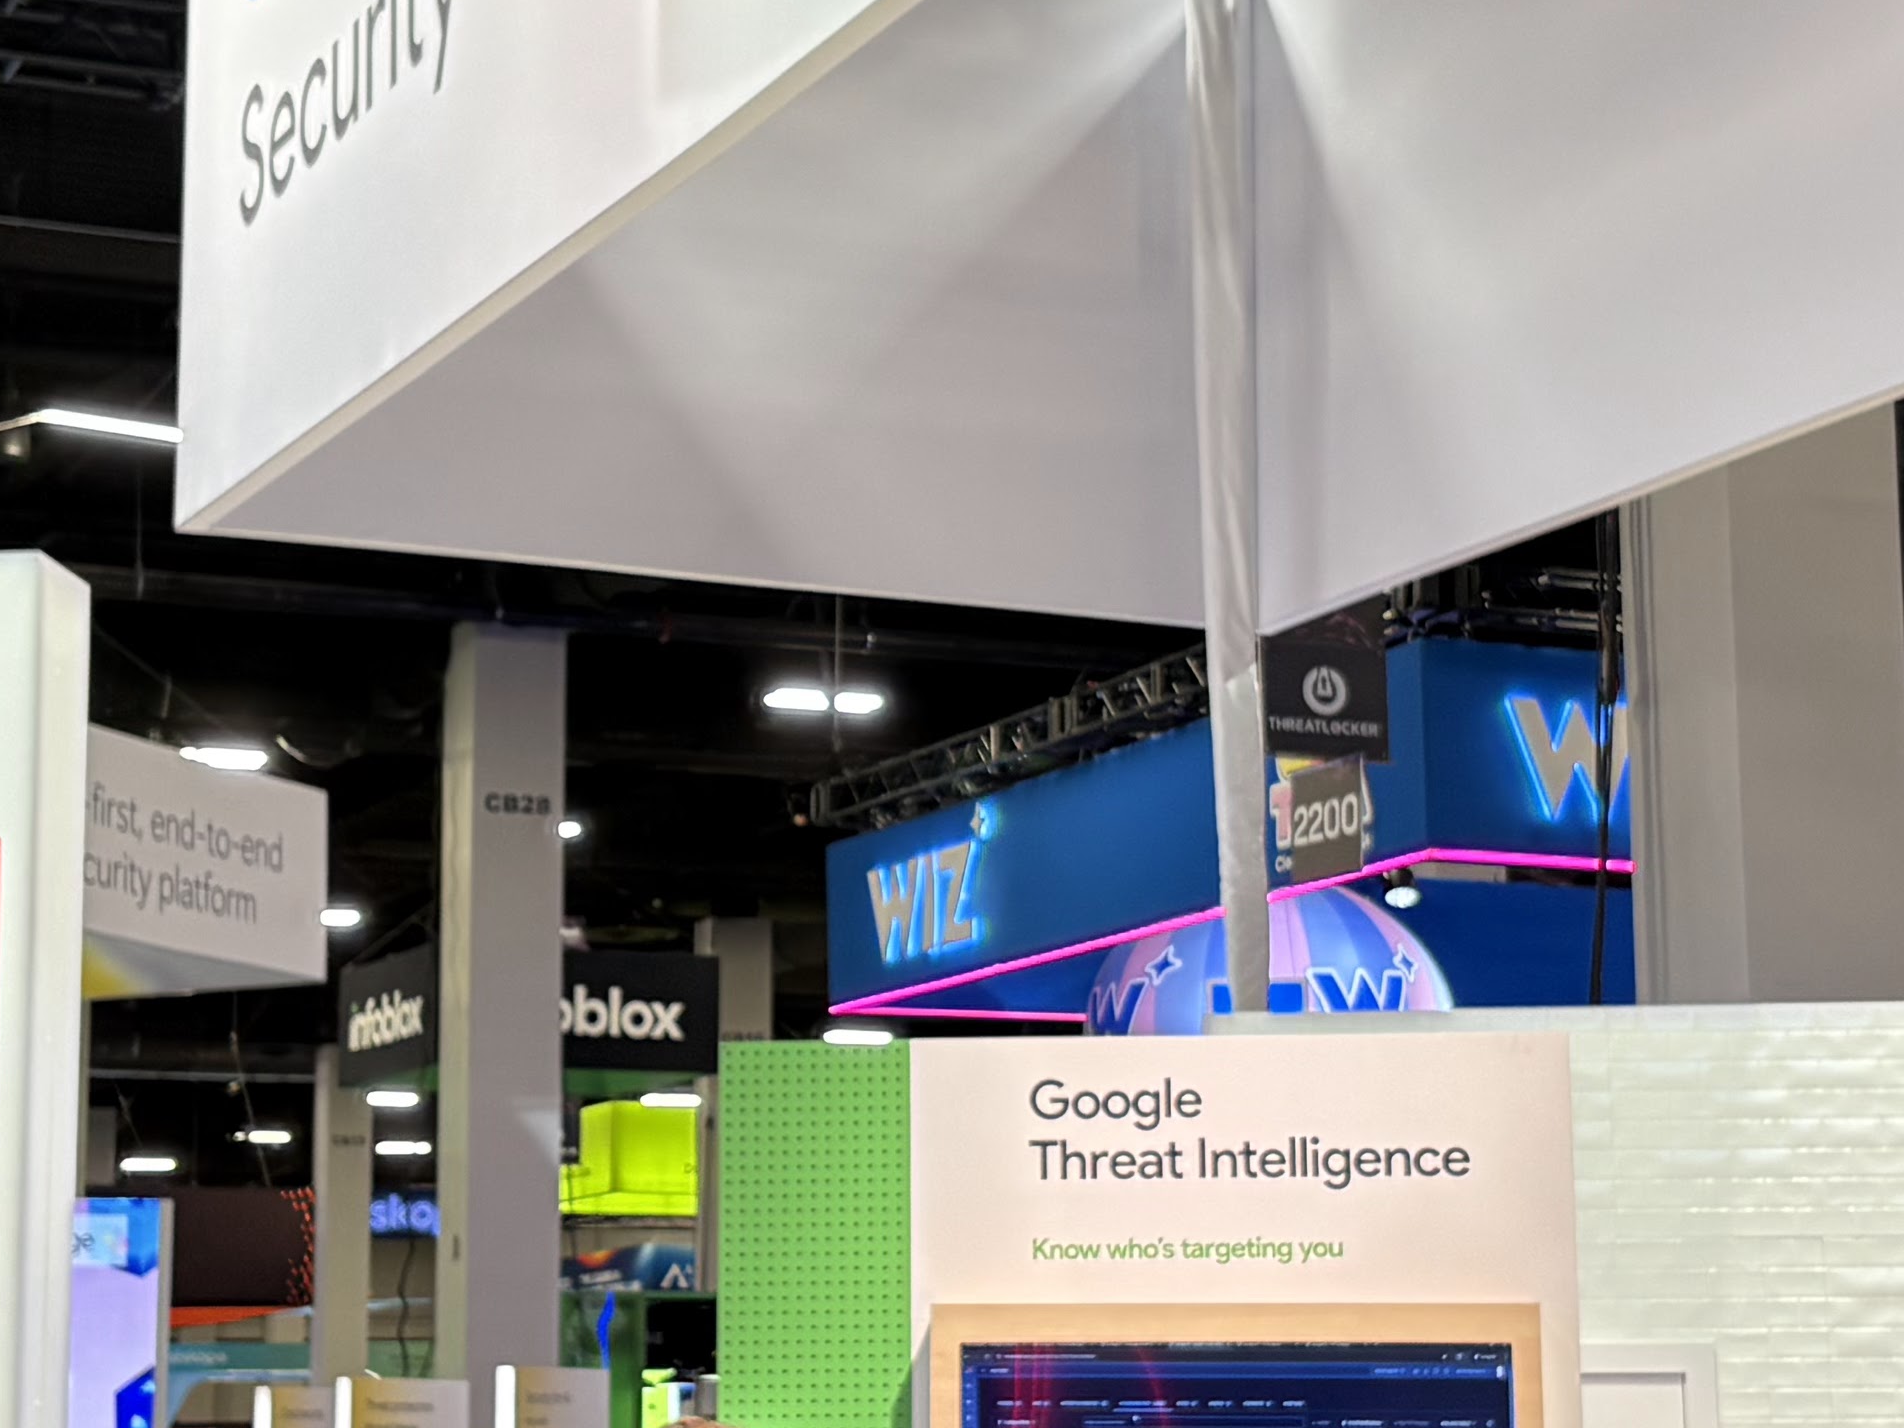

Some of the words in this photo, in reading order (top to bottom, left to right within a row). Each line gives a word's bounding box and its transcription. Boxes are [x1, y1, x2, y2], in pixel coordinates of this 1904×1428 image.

[1269, 716, 1379, 738] THREATLOCKER
[150, 809, 284, 873] end-to-end
[1294, 792, 1358, 847] 2200
[83, 851, 152, 910] curity
[158, 864, 257, 923] platform
[867, 834, 984, 963] WIZ
[349, 988, 424, 1052] infoblox
[562, 984, 685, 1042] blox
[1029, 1076, 1203, 1131] Google
[1030, 1138, 1184, 1181] Threat
[1199, 1136, 1471, 1191] Intelligence
[1032, 1237, 1101, 1261] Know
[1106, 1236, 1175, 1261] who's
[1181, 1235, 1293, 1265] targeting
[1298, 1242, 1345, 1265] you
